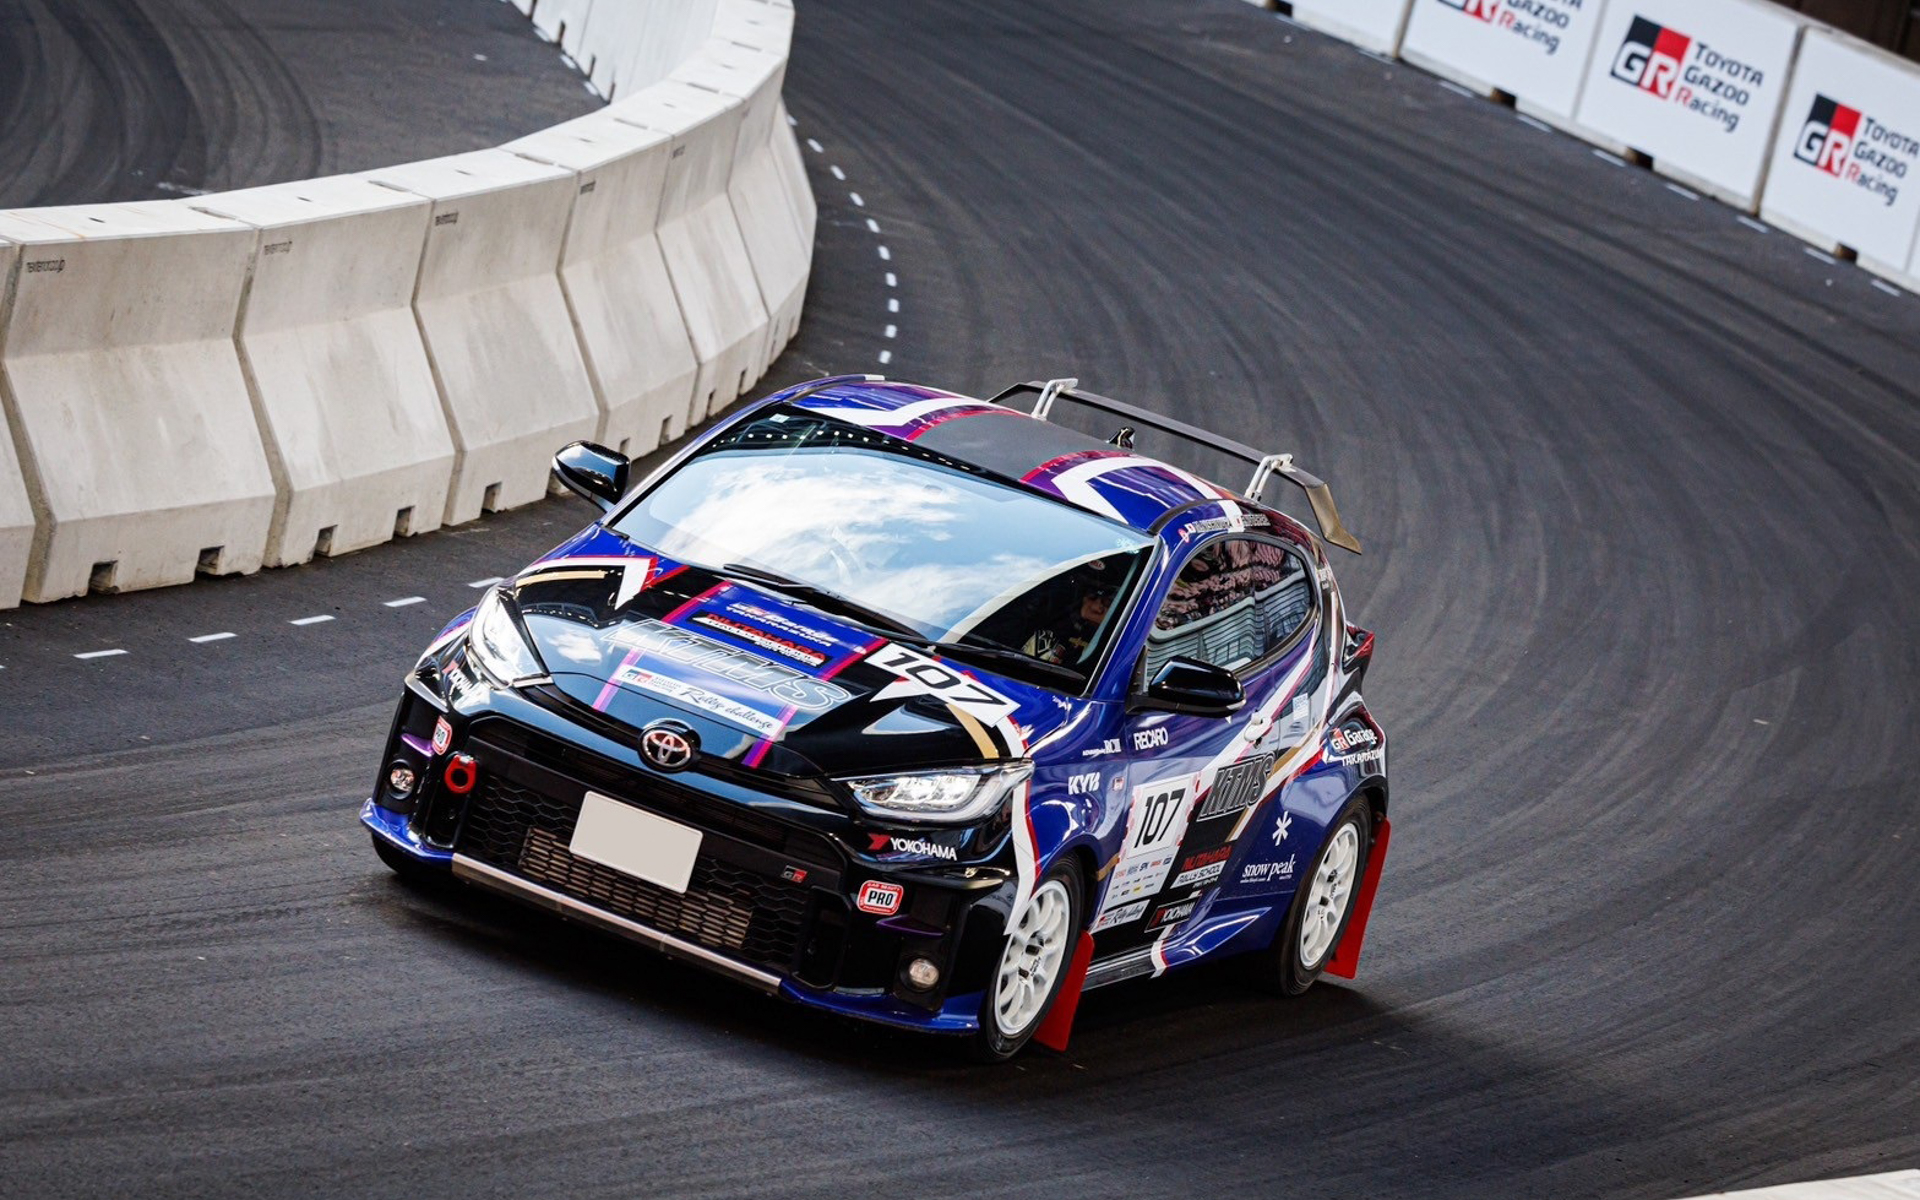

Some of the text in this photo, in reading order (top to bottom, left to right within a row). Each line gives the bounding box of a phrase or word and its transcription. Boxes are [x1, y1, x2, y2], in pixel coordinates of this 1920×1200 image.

[1499, 10, 1560, 55] Racing
[1611, 40, 1682, 100] GR
[1683, 64, 1750, 106] GAZOO
[1694, 41, 1764, 87] TOYOTA
[1674, 86, 1740, 133] Racing
[1795, 119, 1853, 177] GR
[1863, 116, 1920, 158] TOYOTA
[1853, 141, 1908, 179] GAZOO
[1845, 162, 1899, 207] Racing
[882, 652, 1008, 706] 107
[679, 687, 773, 729] Rally challenge
[1133, 726, 1169, 751] RECARO
[1343, 729, 1377, 746] Garage
[1068, 772, 1101, 795] KYB
[1134, 787, 1187, 849] 107
[890, 836, 957, 861] YOKOHAMA
[1242, 853, 1296, 882] snow peak
[867, 890, 894, 906] PRO
